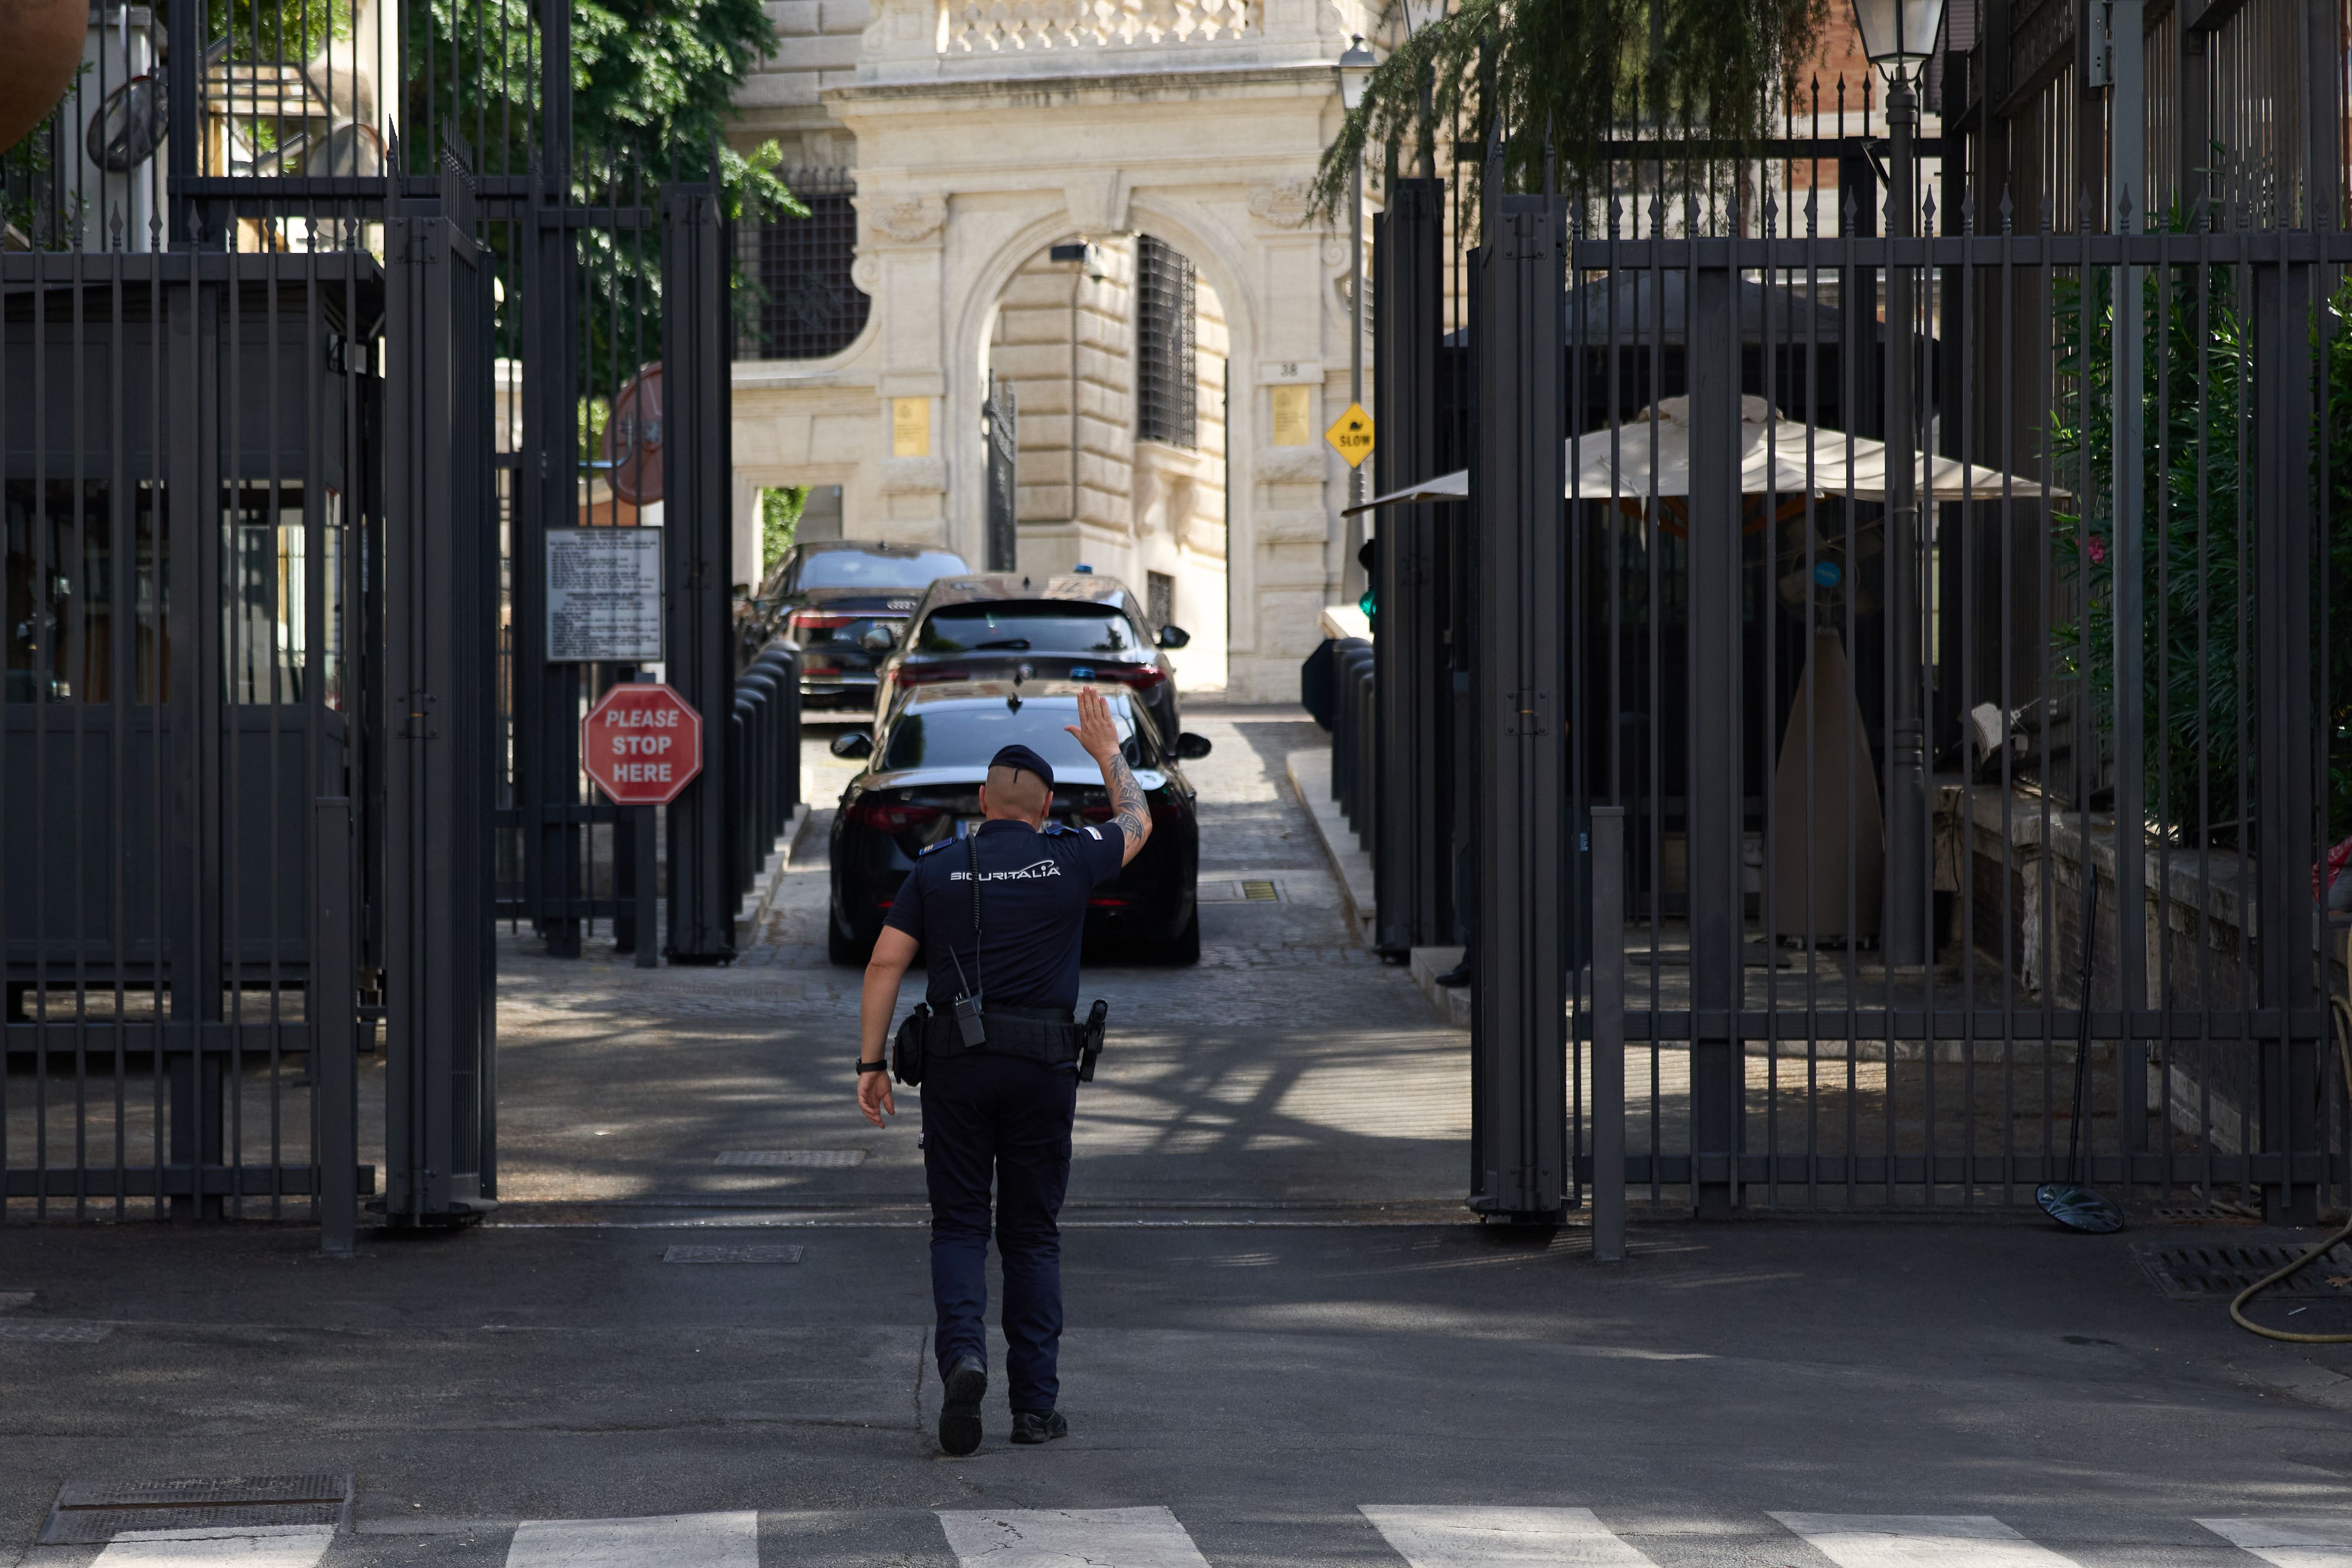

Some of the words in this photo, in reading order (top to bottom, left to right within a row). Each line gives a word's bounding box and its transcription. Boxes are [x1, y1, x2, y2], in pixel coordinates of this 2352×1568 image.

[1281, 364, 1298, 377] 38
[1340, 435, 1371, 447] SLOW
[605, 710, 679, 728] PLEASE
[612, 736, 672, 755] STOP
[613, 763, 672, 783] HERE
